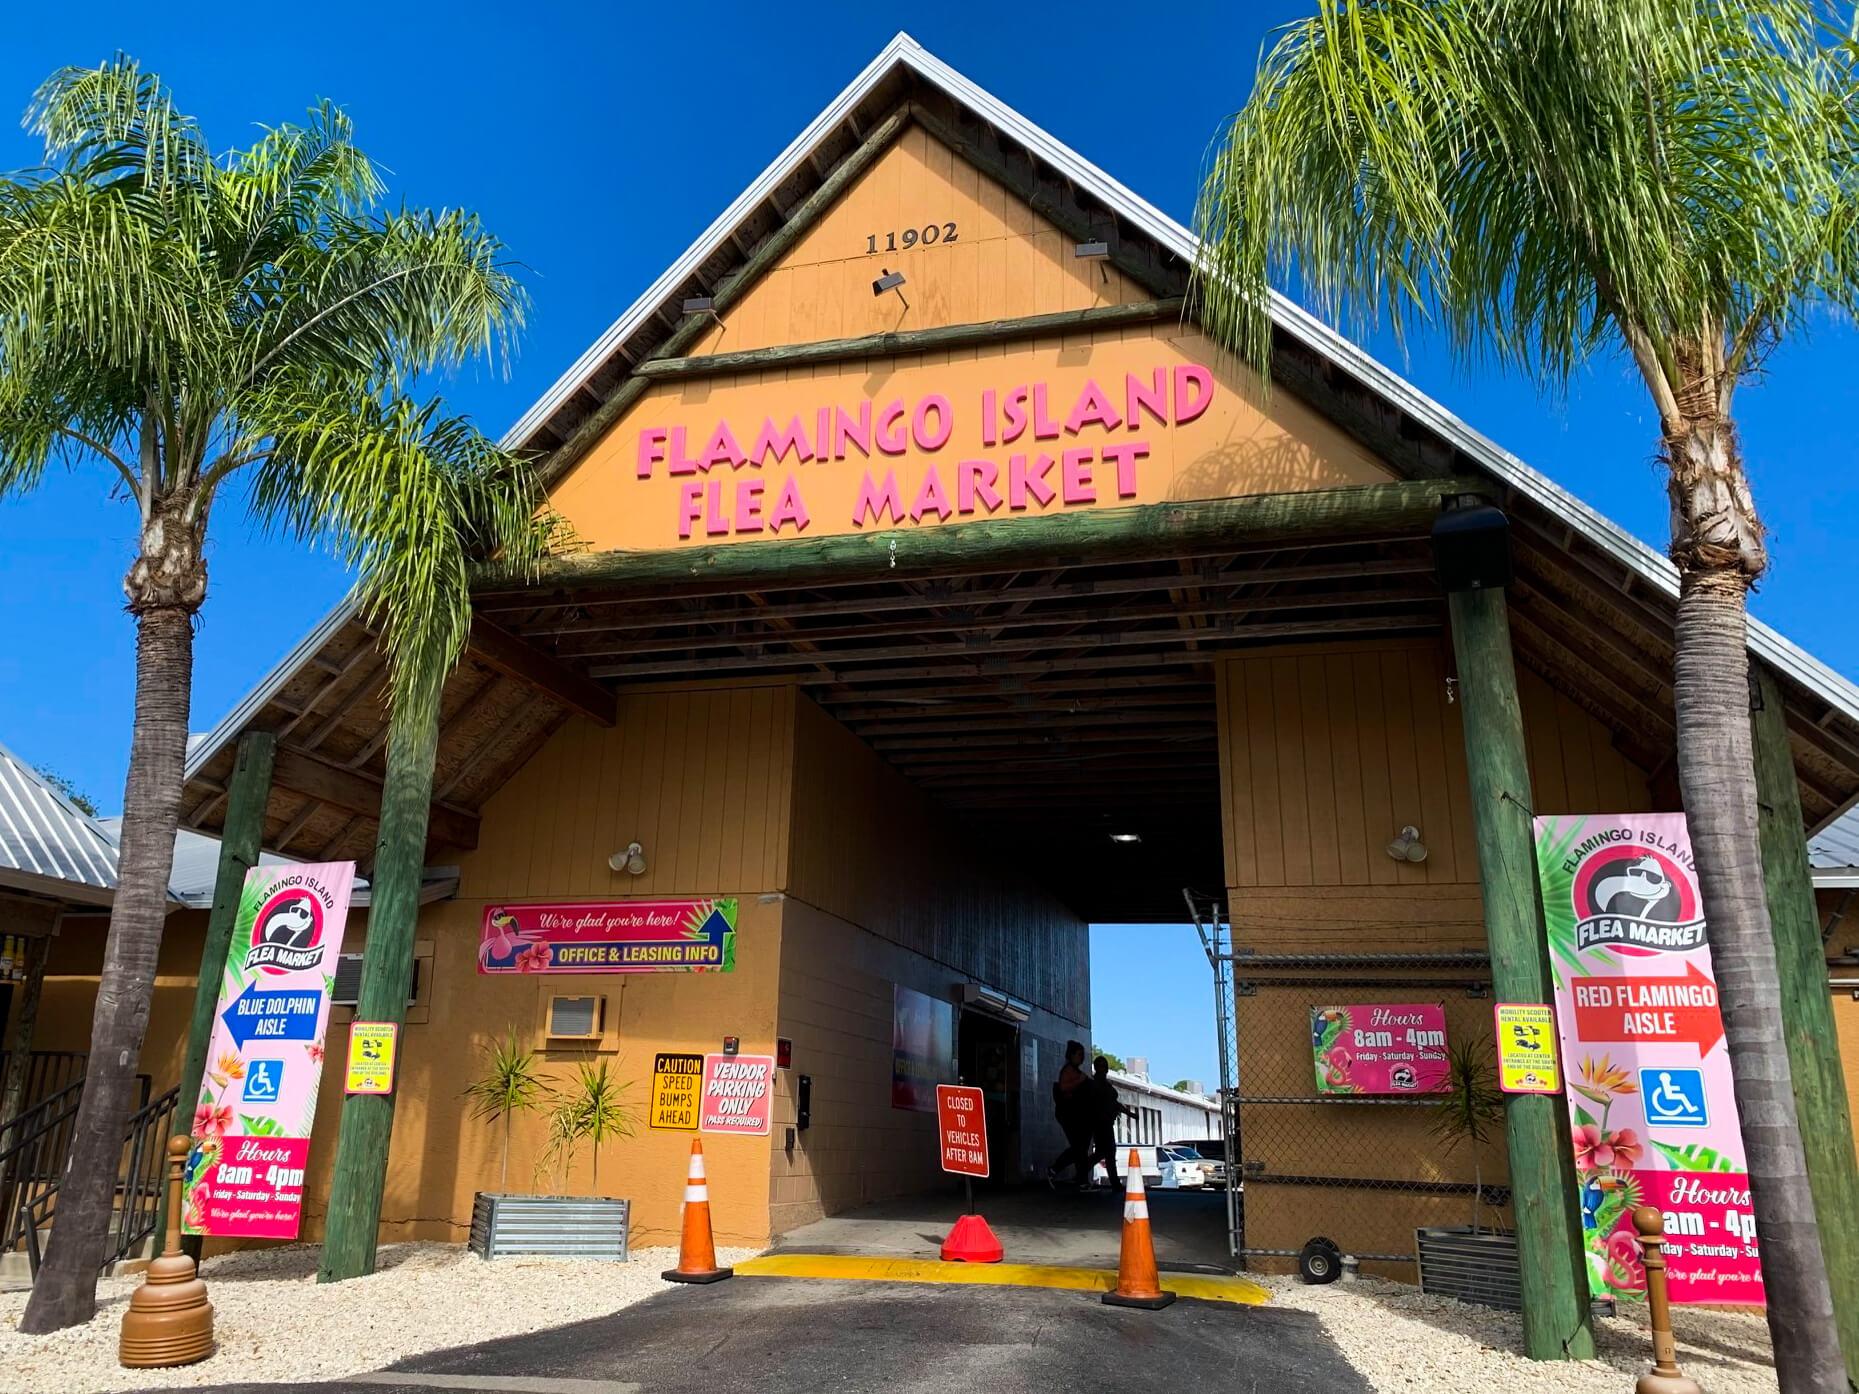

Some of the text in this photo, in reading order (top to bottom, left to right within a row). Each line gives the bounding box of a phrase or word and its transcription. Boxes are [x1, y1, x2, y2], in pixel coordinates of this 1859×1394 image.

[866, 222, 959, 254] 11902
[637, 364, 1214, 480] FLAMINGO ISLAND
[678, 441, 1150, 540] FLEA MARKET
[1562, 828, 1633, 874] FLAMINGO
[253, 875, 334, 912] FLAMINGO ISLAND
[540, 911, 681, 934] We're glad you're here!
[1578, 919, 1707, 947] FLEA MARKET
[246, 946, 324, 968] FLEA MARKET
[559, 945, 718, 962] OFFICE & LEASING INFO
[1575, 985, 1716, 1007] RED FLAMINGO
[237, 997, 316, 1015] BLUE DOLPHIN
[1370, 1008, 1424, 1026] Hours
[1623, 1012, 1677, 1034] AISLE
[255, 1018, 287, 1035] AISLE
[1353, 1029, 1393, 1047] 8am
[1406, 1028, 1445, 1050] 4pm
[657, 1058, 701, 1074] CAUTION
[1356, 1052, 1378, 1061] Friday
[1383, 1052, 1414, 1062] Saturday
[1420, 1052, 1446, 1061] Sunday
[713, 1062, 767, 1080] VENDOR
[662, 1075, 693, 1090] SPEED
[706, 1080, 766, 1098] PARKING
[659, 1093, 693, 1107] BUMPS
[718, 1098, 755, 1115] ONLY
[947, 1096, 974, 1111] CLOSED
[658, 1109, 691, 1124] AHEAD
[705, 1116, 764, 1128] (PASS REQUIRED)
[957, 1114, 966, 1128] TO
[947, 1130, 980, 1147] VEHICLES
[236, 1140, 291, 1162] Hours
[946, 1147, 984, 1165] AFTER 8AM
[216, 1163, 253, 1184] 8am
[265, 1165, 305, 1191] 4pm
[213, 1190, 232, 1201] Friday
[236, 1190, 270, 1202] Saturday
[275, 1192, 301, 1204] Sunday
[1669, 1176, 1752, 1206] Hours
[1662, 1211, 1705, 1236] am
[1725, 1209, 1758, 1244] 4p
[1690, 1243, 1738, 1259] Saturday
[1689, 1268, 1717, 1285] glad
[1717, 1270, 1752, 1286] you're
